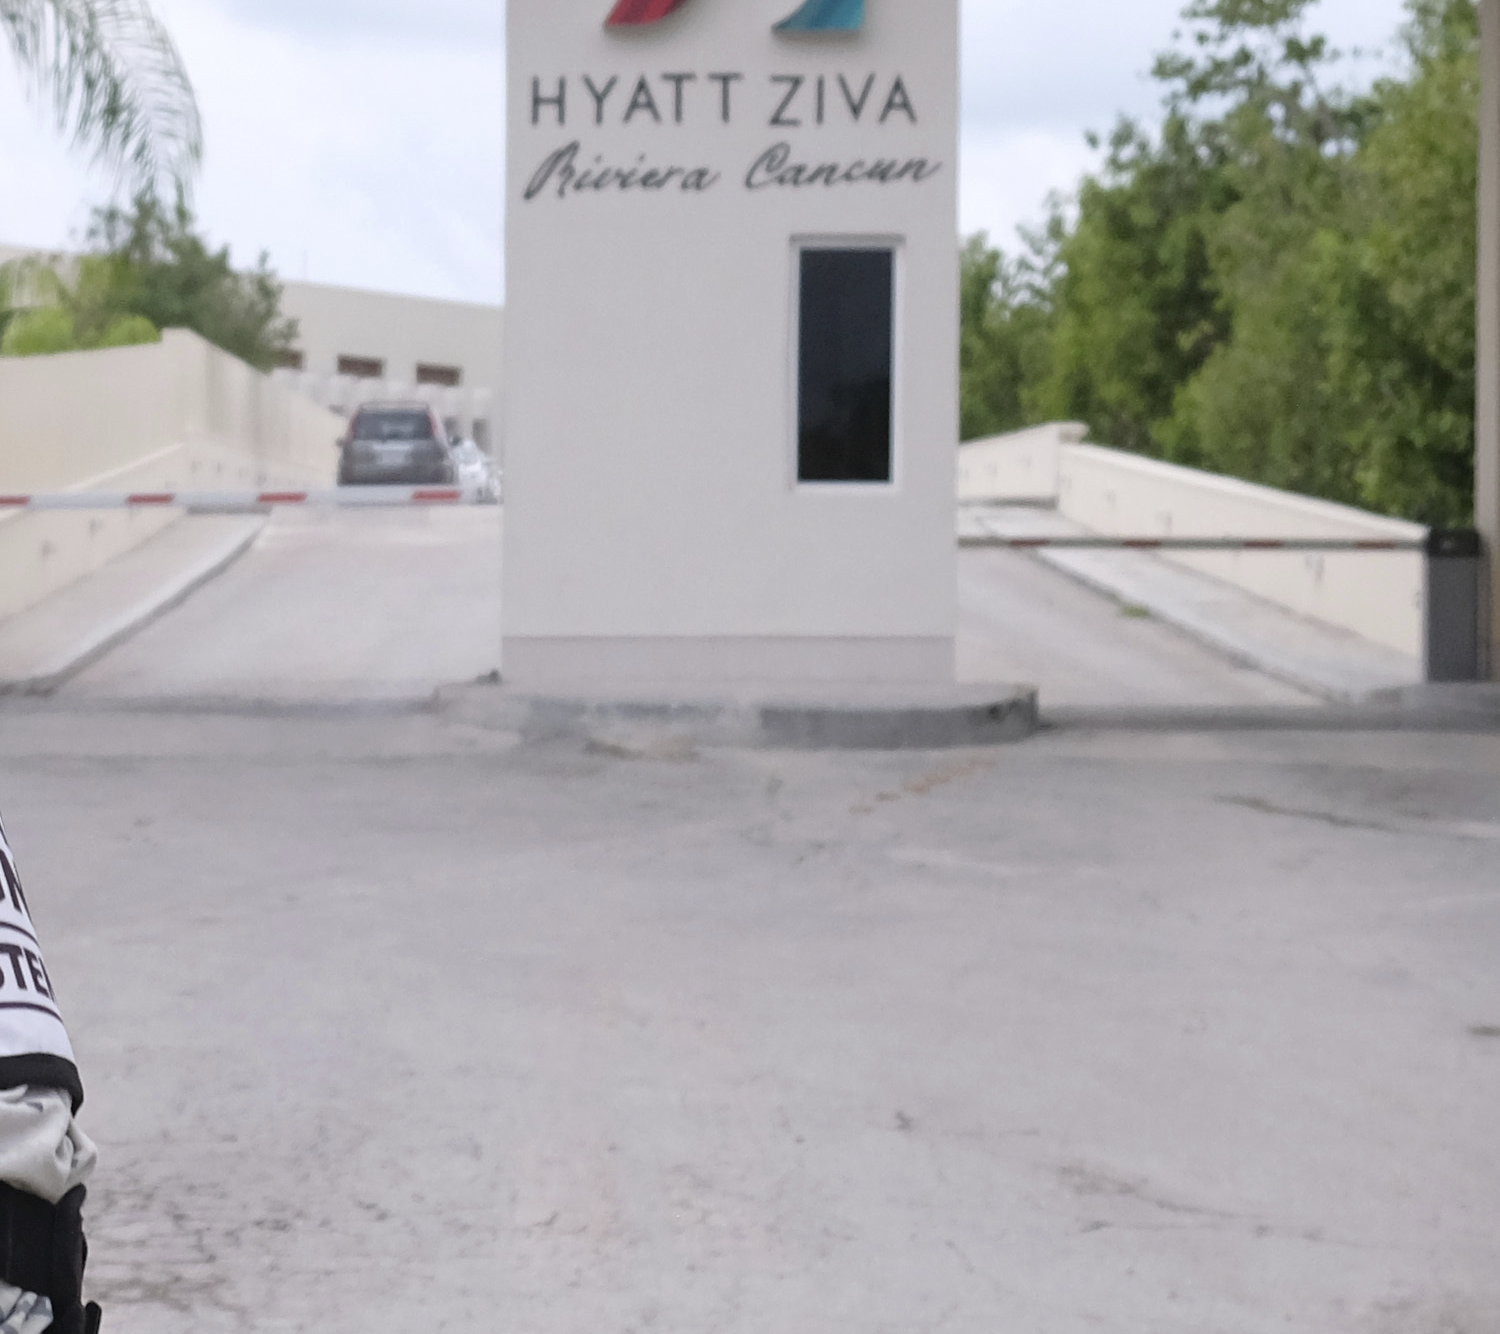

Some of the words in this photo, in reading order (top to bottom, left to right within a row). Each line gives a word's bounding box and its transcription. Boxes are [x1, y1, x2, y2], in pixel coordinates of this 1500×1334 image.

[530, 72, 743, 126] HYATT
[769, 72, 918, 127] ZIVA
[523, 140, 721, 200] Riviera
[744, 141, 943, 190] Cancun
